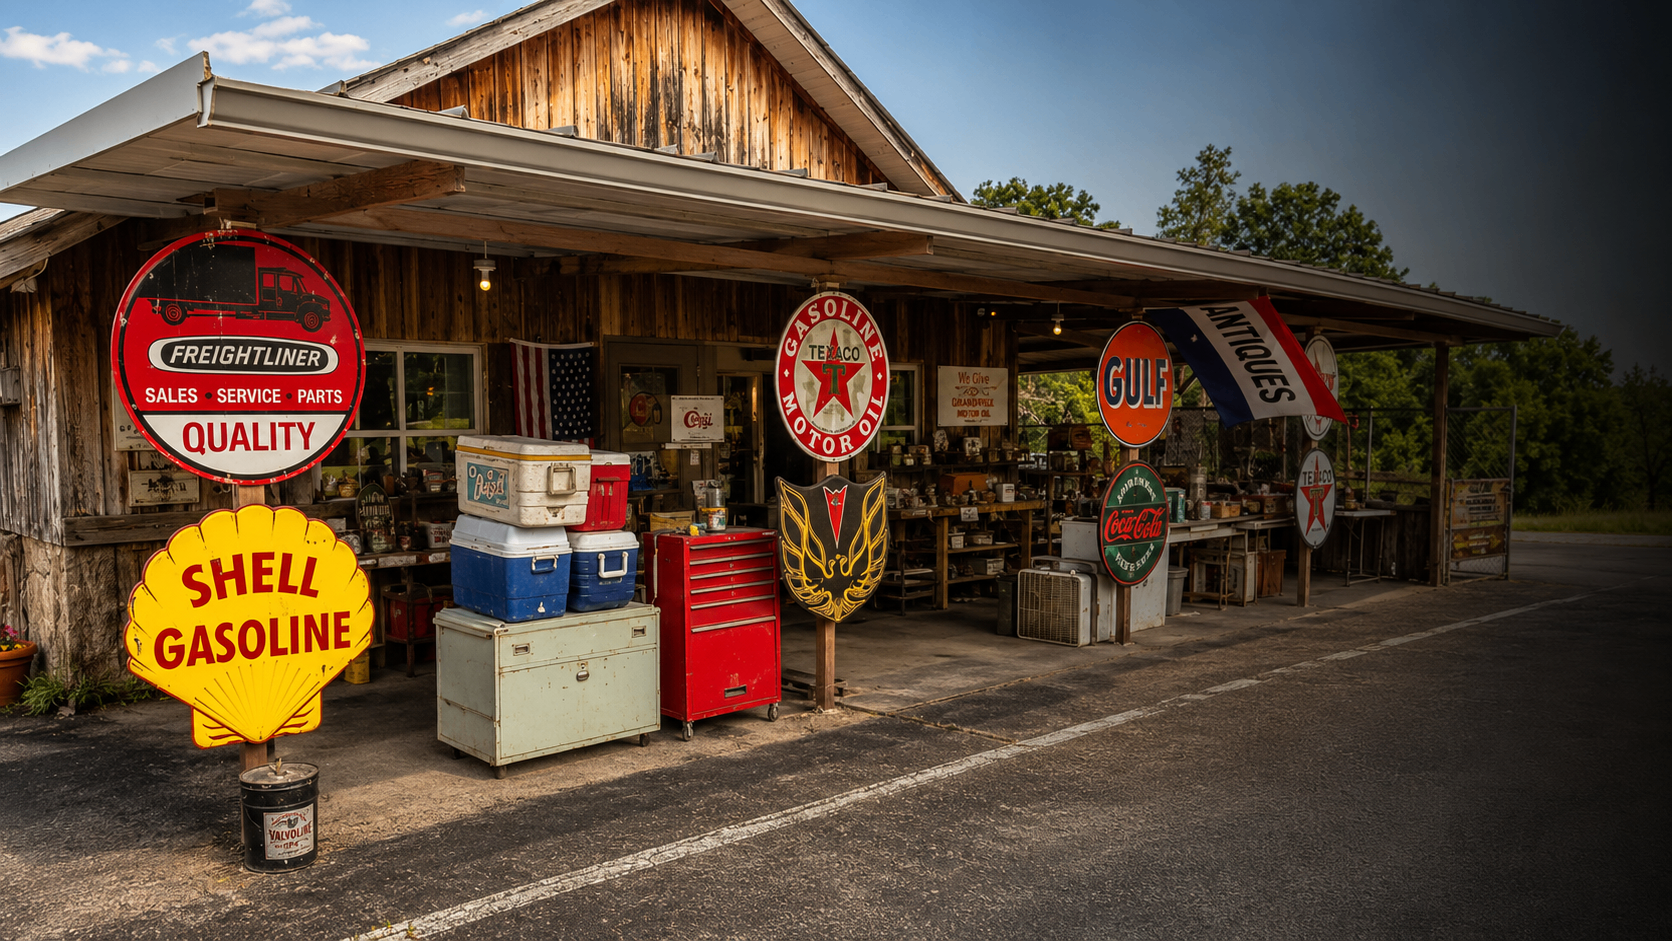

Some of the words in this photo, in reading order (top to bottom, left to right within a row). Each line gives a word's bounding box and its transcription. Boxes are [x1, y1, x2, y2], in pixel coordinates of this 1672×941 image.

[168, 340, 322, 367] FREIGHTLINER
[785, 298, 883, 362] GASOLINE
[1200, 306, 1296, 404] ANTIQUES
[145, 387, 198, 404] SALES
[216, 387, 282, 404] SERVICE
[297, 388, 343, 404] PARTS
[1103, 355, 1169, 409] GULF
[183, 421, 316, 456] QUALITY
[783, 391, 854, 454] MOTOR
[858, 395, 884, 437] OIL
[182, 551, 319, 609] SHELL
[153, 611, 351, 670] GASOLINE
